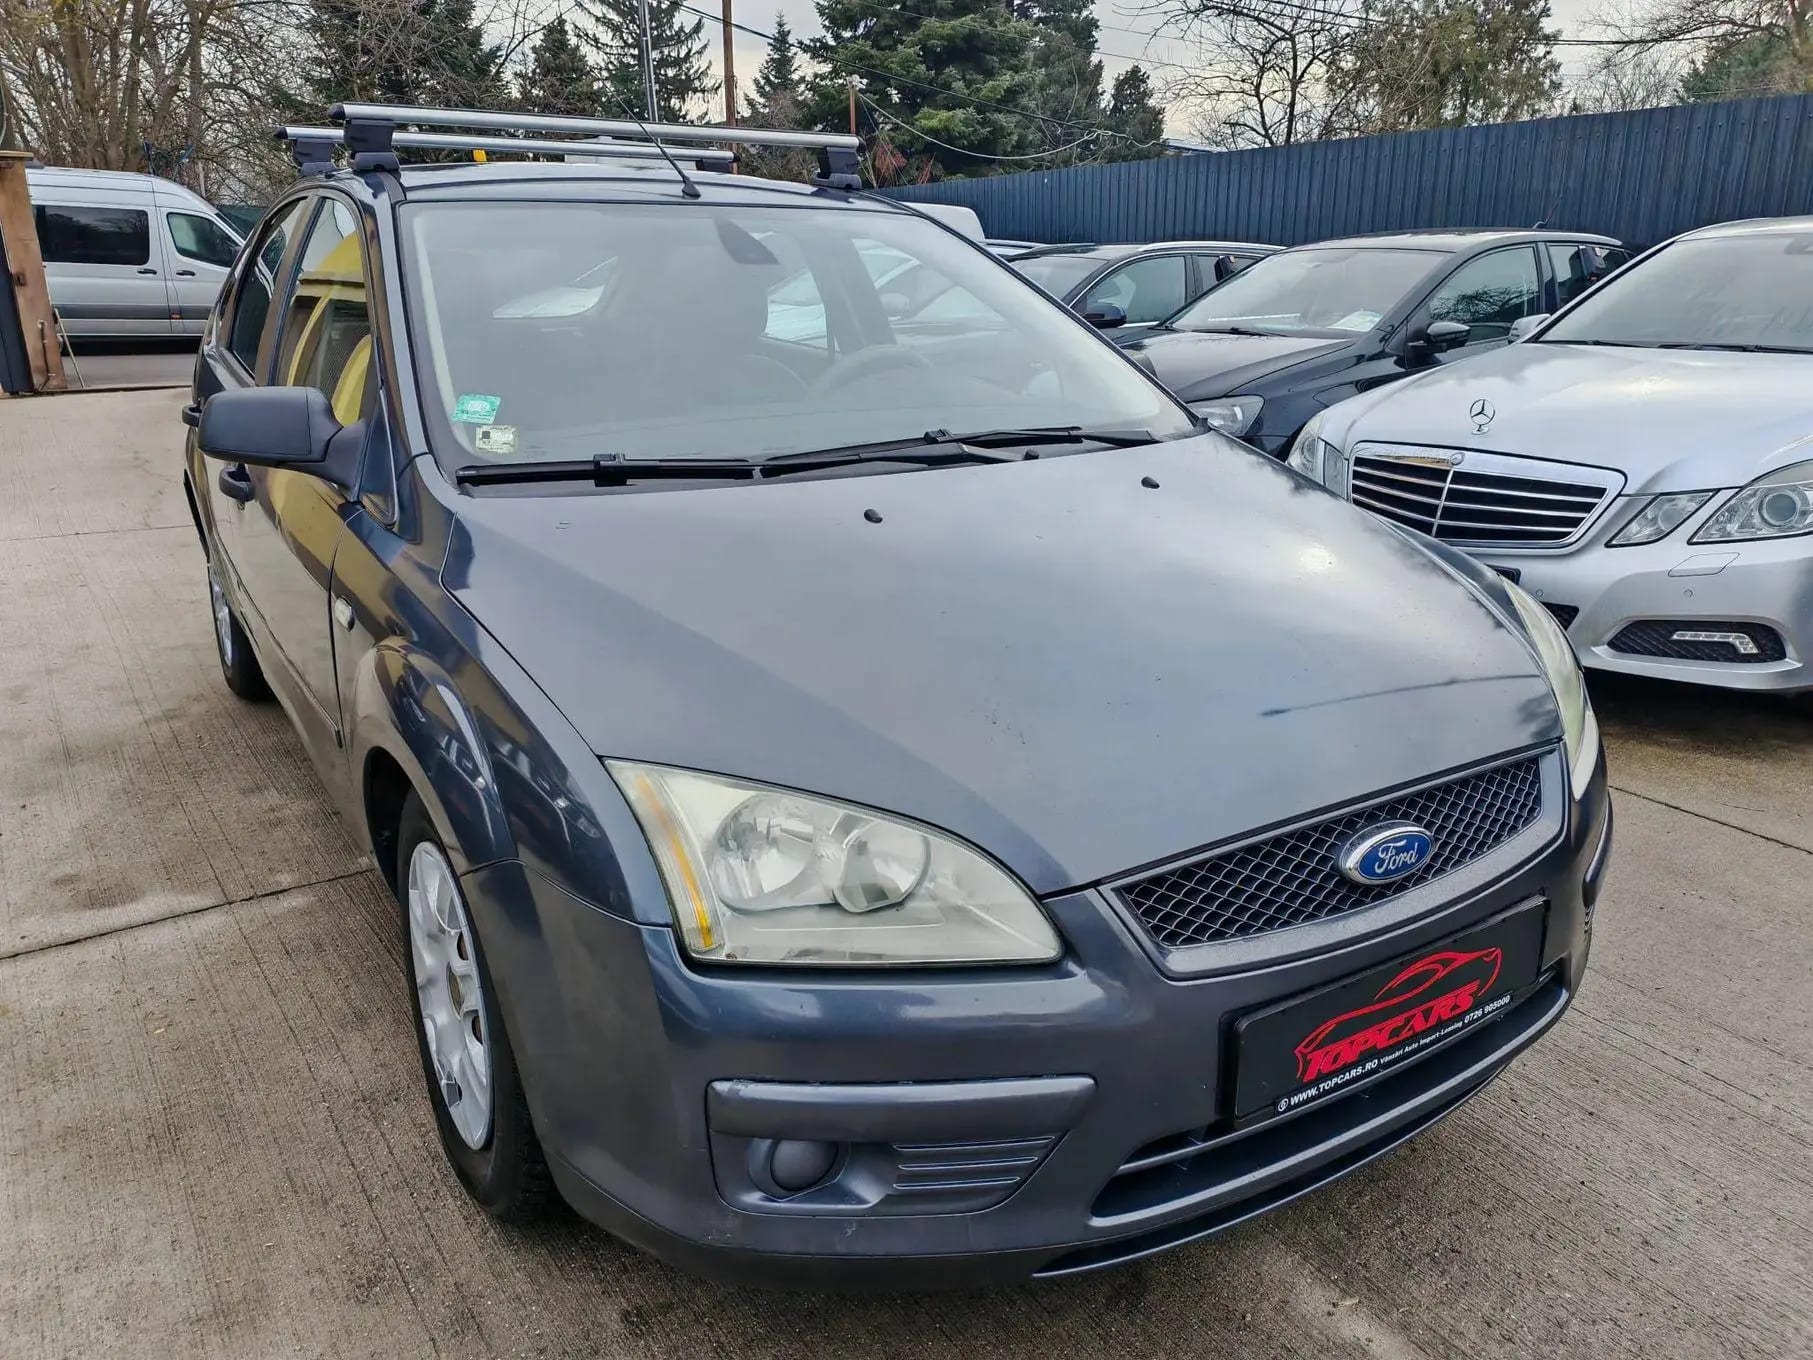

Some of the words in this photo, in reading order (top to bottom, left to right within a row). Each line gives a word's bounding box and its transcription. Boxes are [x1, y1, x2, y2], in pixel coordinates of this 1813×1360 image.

[1375, 839, 1418, 873] Ford
[1290, 1059, 1378, 1106] WWW.TOPCARS.RO
[1404, 1042, 1419, 1054] Auto
[1464, 1008, 1483, 1024] 0726
[1303, 979, 1480, 1083] TOPCARS
